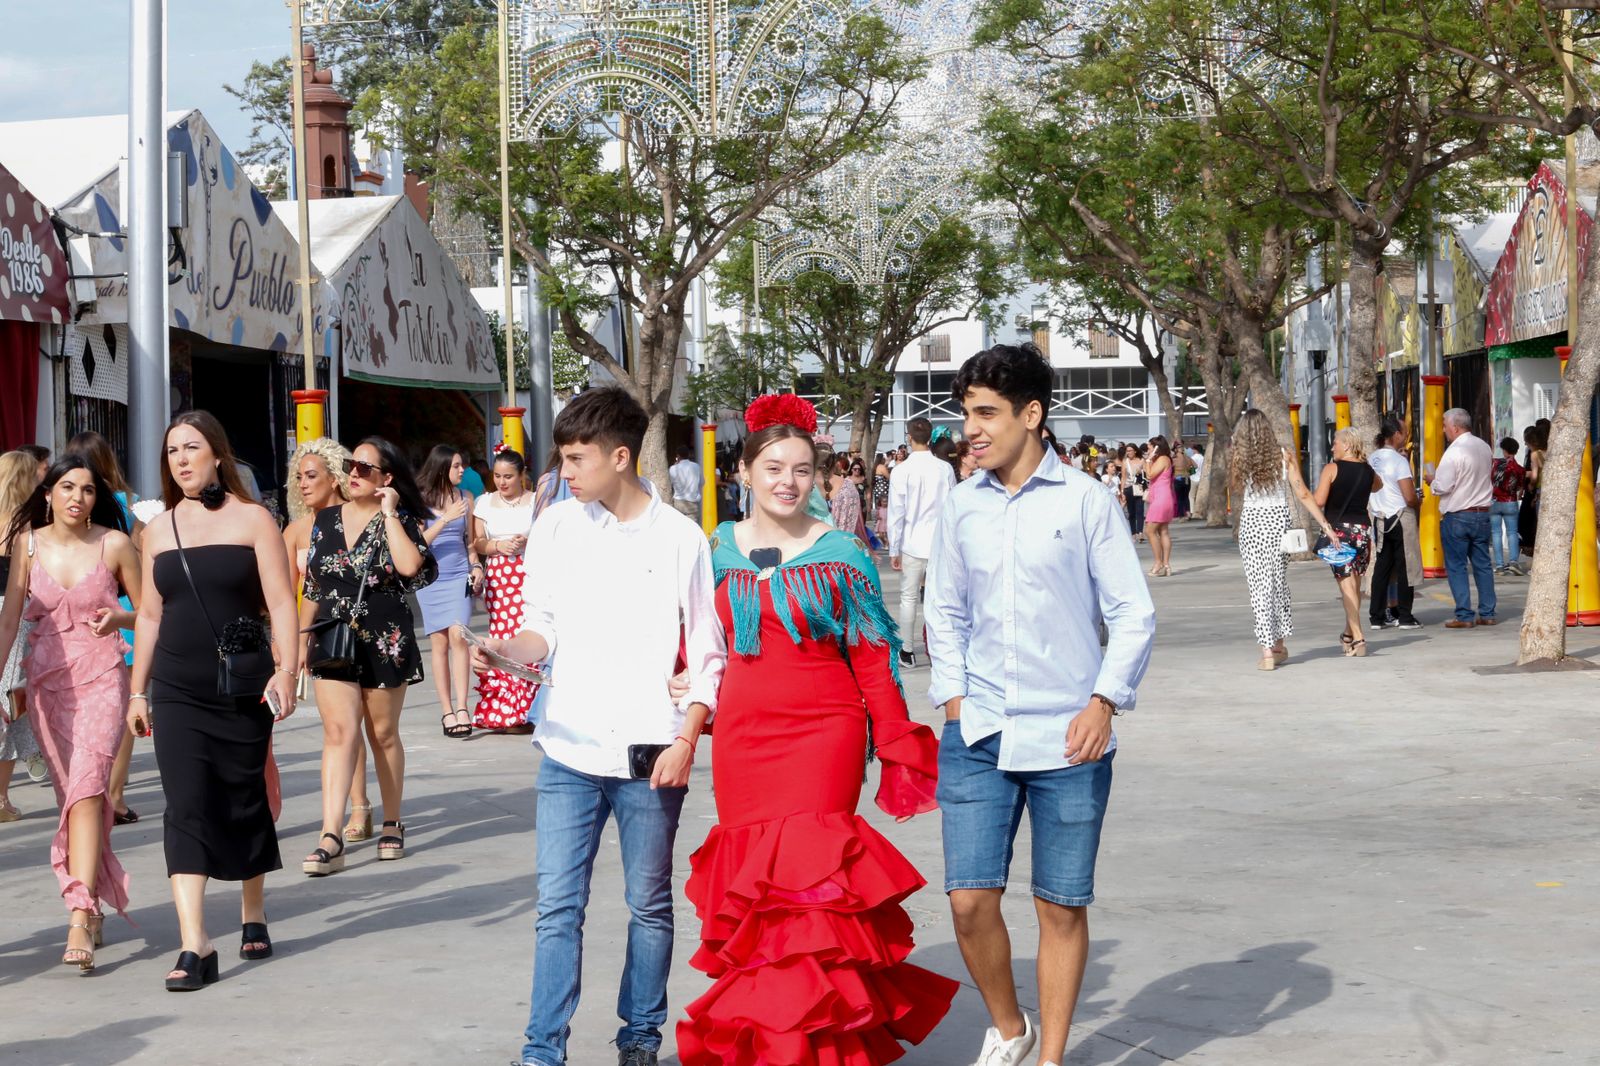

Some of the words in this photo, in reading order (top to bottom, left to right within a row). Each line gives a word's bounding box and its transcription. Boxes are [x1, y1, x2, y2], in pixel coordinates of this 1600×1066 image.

[2, 227, 41, 264] Desde
[8, 260, 45, 294] 1986
[213, 218, 296, 315] Pueblo
